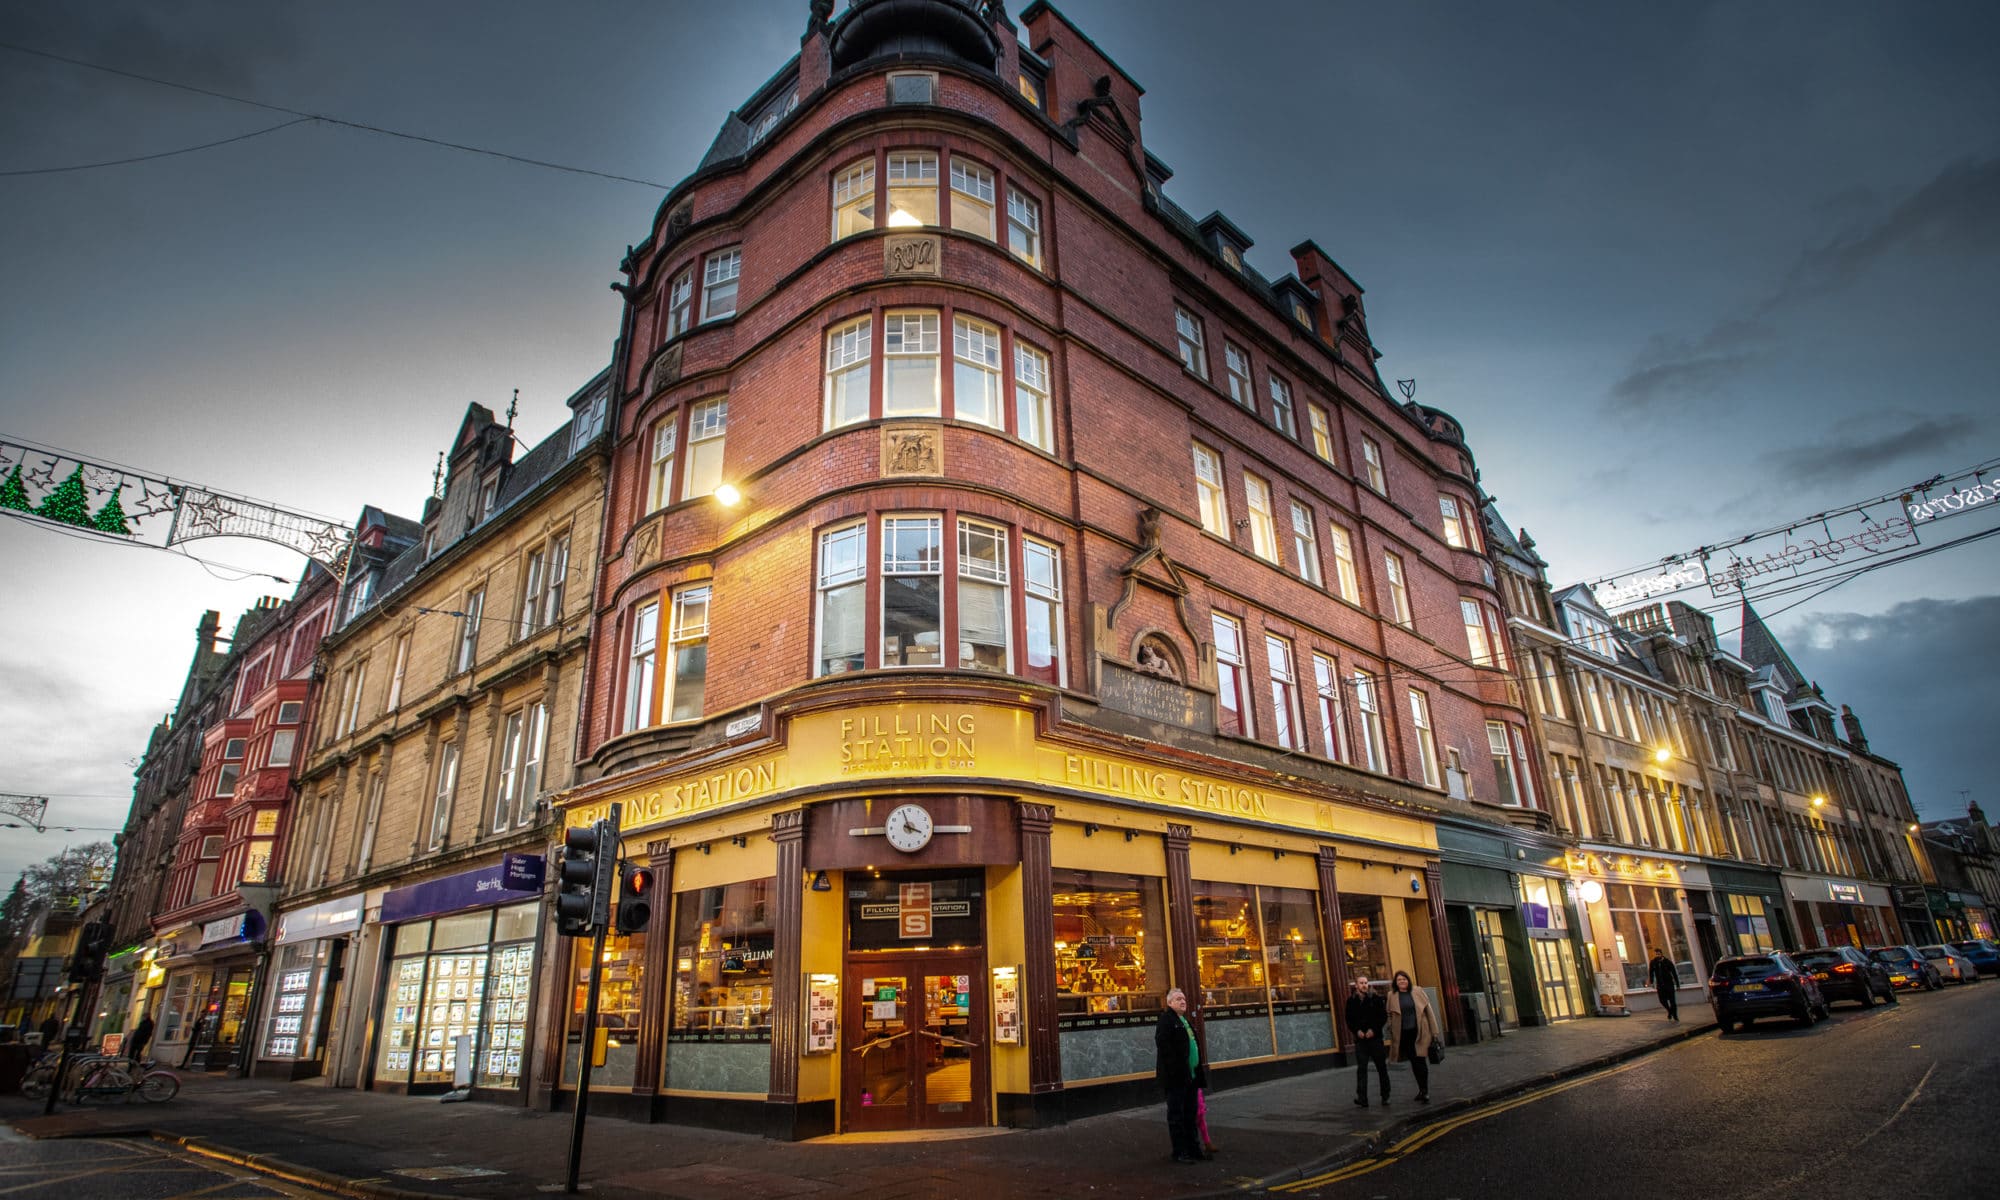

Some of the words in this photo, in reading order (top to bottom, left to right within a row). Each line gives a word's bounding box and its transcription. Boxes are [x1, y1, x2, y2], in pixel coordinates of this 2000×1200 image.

[841, 713, 976, 740] FILLING
[841, 737, 976, 763] STATION
[949, 760, 976, 770] BAR
[584, 793, 663, 829] FIING
[673, 760, 775, 810] STATION
[1065, 755, 1167, 798] FILLING
[1180, 778, 1267, 816] STATION
[907, 888, 925, 906] F
[866, 906, 899, 915] FILLING
[933, 904, 966, 912] STATION
[905, 914, 926, 933] S
